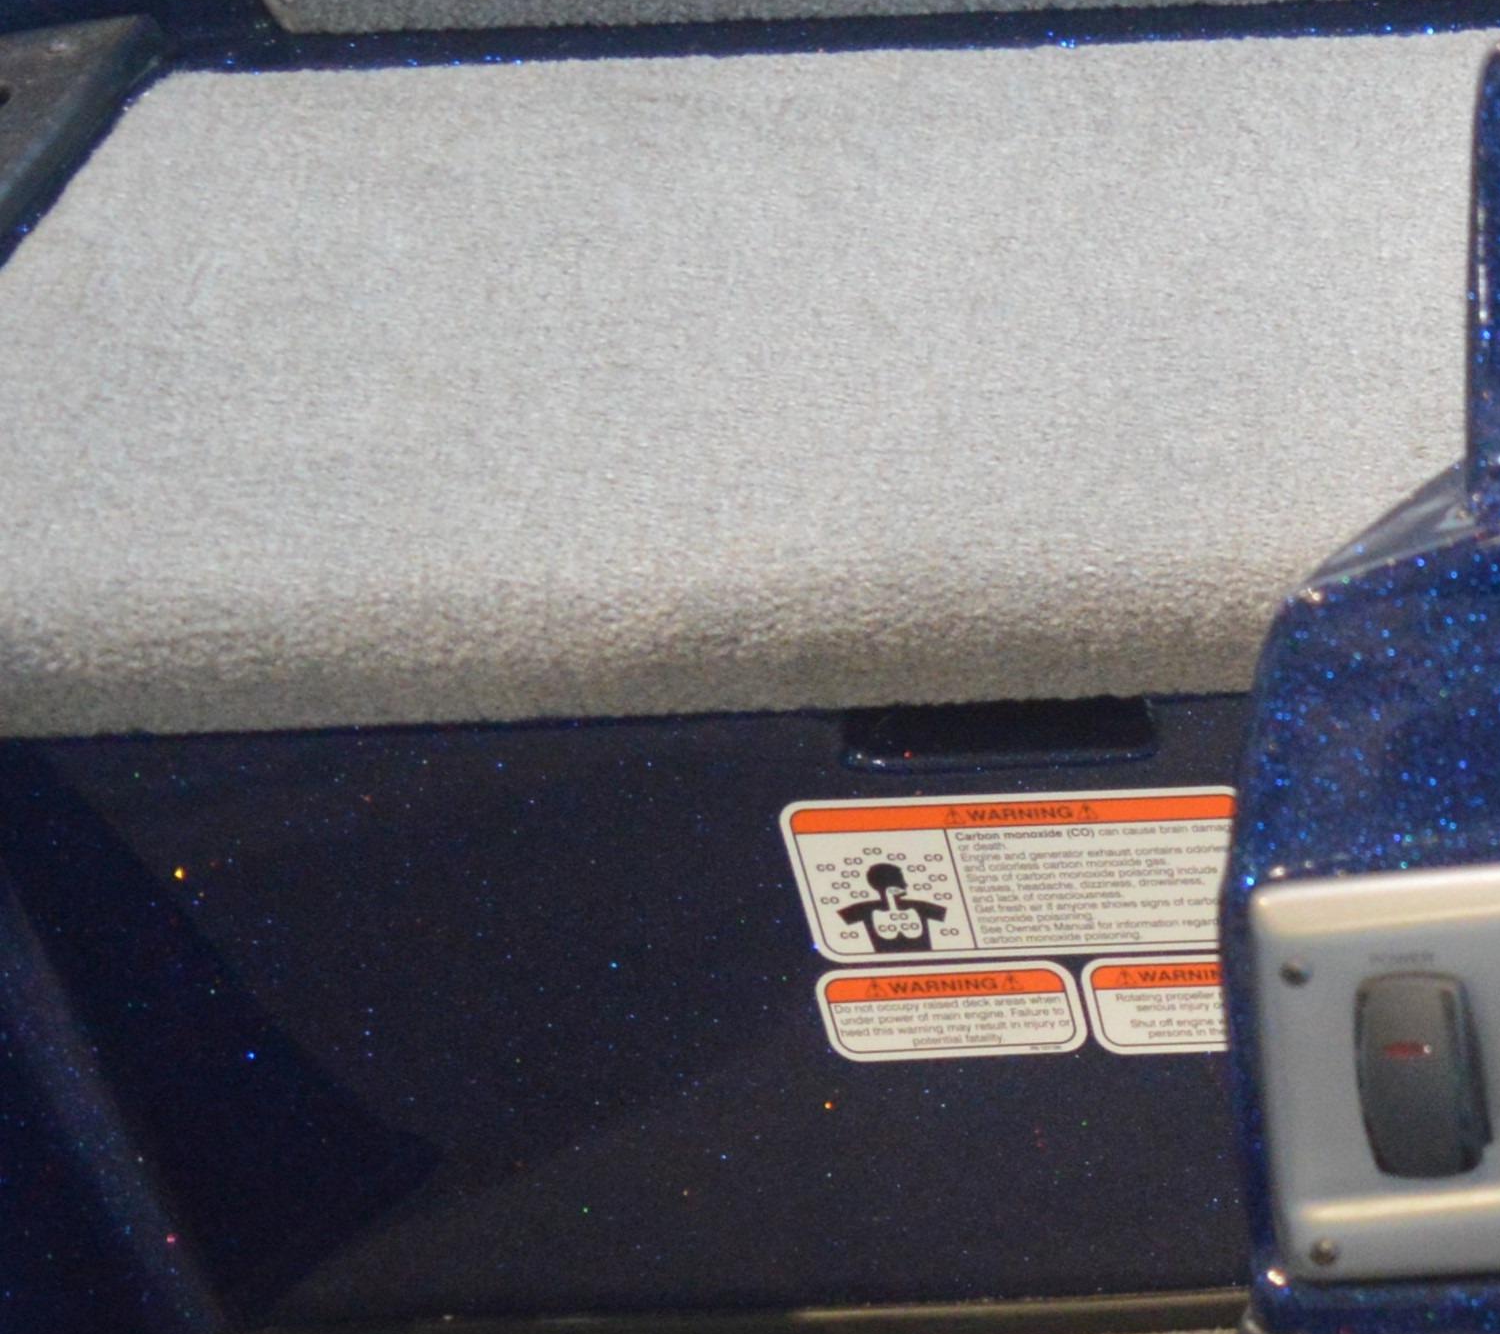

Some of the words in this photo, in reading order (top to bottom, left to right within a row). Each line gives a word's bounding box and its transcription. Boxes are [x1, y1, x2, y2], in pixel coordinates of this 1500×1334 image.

[967, 805, 1074, 822] WARNING
[955, 831, 1000, 841] Carbon
[1003, 829, 1062, 839] monoxide
[1067, 827, 1095, 839] (CO)
[1098, 828, 1119, 836] can
[1123, 826, 1157, 835] cause
[1160, 823, 1188, 834] brain
[1192, 821, 1232, 835] damag
[862, 847, 882, 855] CO
[958, 842, 969, 851] or
[886, 853, 906, 861] CO
[924, 853, 943, 862] CO
[960, 851, 1000, 863] Engine
[1005, 851, 1026, 861] and
[1030, 849, 1083, 861] generator
[1087, 847, 1132, 857] exhaust
[1135, 845, 1182, 855] contains
[843, 857, 863, 865] CO
[964, 862, 985, 872] and
[1043, 859, 1083, 869] carbon
[1086, 857, 1142, 867] monoxide
[1145, 857, 1167, 868] gas.
[816, 863, 836, 872] CO
[907, 864, 926, 873] CO
[841, 870, 860, 878] CO
[928, 873, 948, 882] CO
[966, 873, 999, 884] Signs
[1002, 872, 1013, 881] of
[1016, 870, 1055, 880] carbon
[1059, 868, 1115, 878] monoxide
[1119, 866, 1174, 878] poisoning
[1178, 864, 1217, 874] include
[831, 881, 851, 890] CO
[913, 882, 932, 891] CO
[850, 890, 869, 899] CO
[933, 892, 953, 900] CO
[972, 894, 993, 903] and
[997, 892, 1019, 902] lack
[1023, 892, 1034, 901] of
[820, 896, 840, 905] CO
[975, 904, 995, 914] Get
[997, 903, 1027, 913] fresh
[1030, 902, 1042, 911] air
[1057, 900, 1099, 912] anyone
[1102, 898, 1138, 908] shows
[1141, 897, 1170, 908] signs
[1173, 896, 1184, 905] of
[1187, 896, 1218, 906] carbo
[889, 913, 908, 921] CO
[977, 913, 1033, 923] monoxide
[878, 924, 897, 932] CO
[900, 922, 919, 931] CO
[980, 924, 1002, 933] See
[1006, 922, 1051, 932] Owner's
[1054, 920, 1095, 930] Manual
[1097, 919, 1113, 929] for
[1116, 917, 1179, 928] information
[1182, 916, 1218, 928] regard
[840, 931, 859, 939] CO
[940, 928, 959, 936] CO
[983, 934, 1023, 944] carbon
[1026, 932, 1081, 942] monoxide
[1085, 929, 1142, 942] poisoning.
[1138, 968, 1222, 982] WARNIN
[888, 978, 998, 995] WARNING
[1115, 993, 1162, 1003] Rotating
[1166, 991, 1214, 1002] propeller
[834, 1004, 851, 1014] Do
[854, 1003, 873, 1013] not
[877, 1002, 920, 1015] occupy
[923, 1000, 959, 1010] raised
[962, 998, 990, 1008] deck
[994, 997, 1026, 1006] areas
[1029, 994, 1062, 1004] when
[1136, 1002, 1176, 1012] serious
[1179, 1001, 1209, 1011] injury
[840, 1016, 875, 1025] under
[878, 1014, 914, 1026] power
[917, 1013, 929, 1022] of
[932, 1012, 961, 1021] main
[964, 1010, 1006, 1023] engine.
[1010, 1008, 1050, 1018] Failure
[1053, 1007, 1065, 1016] to
[840, 1027, 870, 1038] heed
[872, 1026, 894, 1036] this
[897, 1024, 944, 1036] warning
[947, 1022, 971, 1034] may
[974, 1020, 1008, 1030] result
[1011, 1020, 1021, 1029] in
[1024, 1018, 1056, 1030] injury
[1058, 1019, 1070, 1027] or
[1130, 1018, 1157, 1028] Shut
[1160, 1018, 1173, 1027] off
[1177, 1018, 1215, 1029] engine
[1148, 1029, 1192, 1039] persons
[1196, 1028, 1207, 1037] in
[912, 1035, 963, 1047] potential
[966, 1033, 1004, 1045] fatality.
